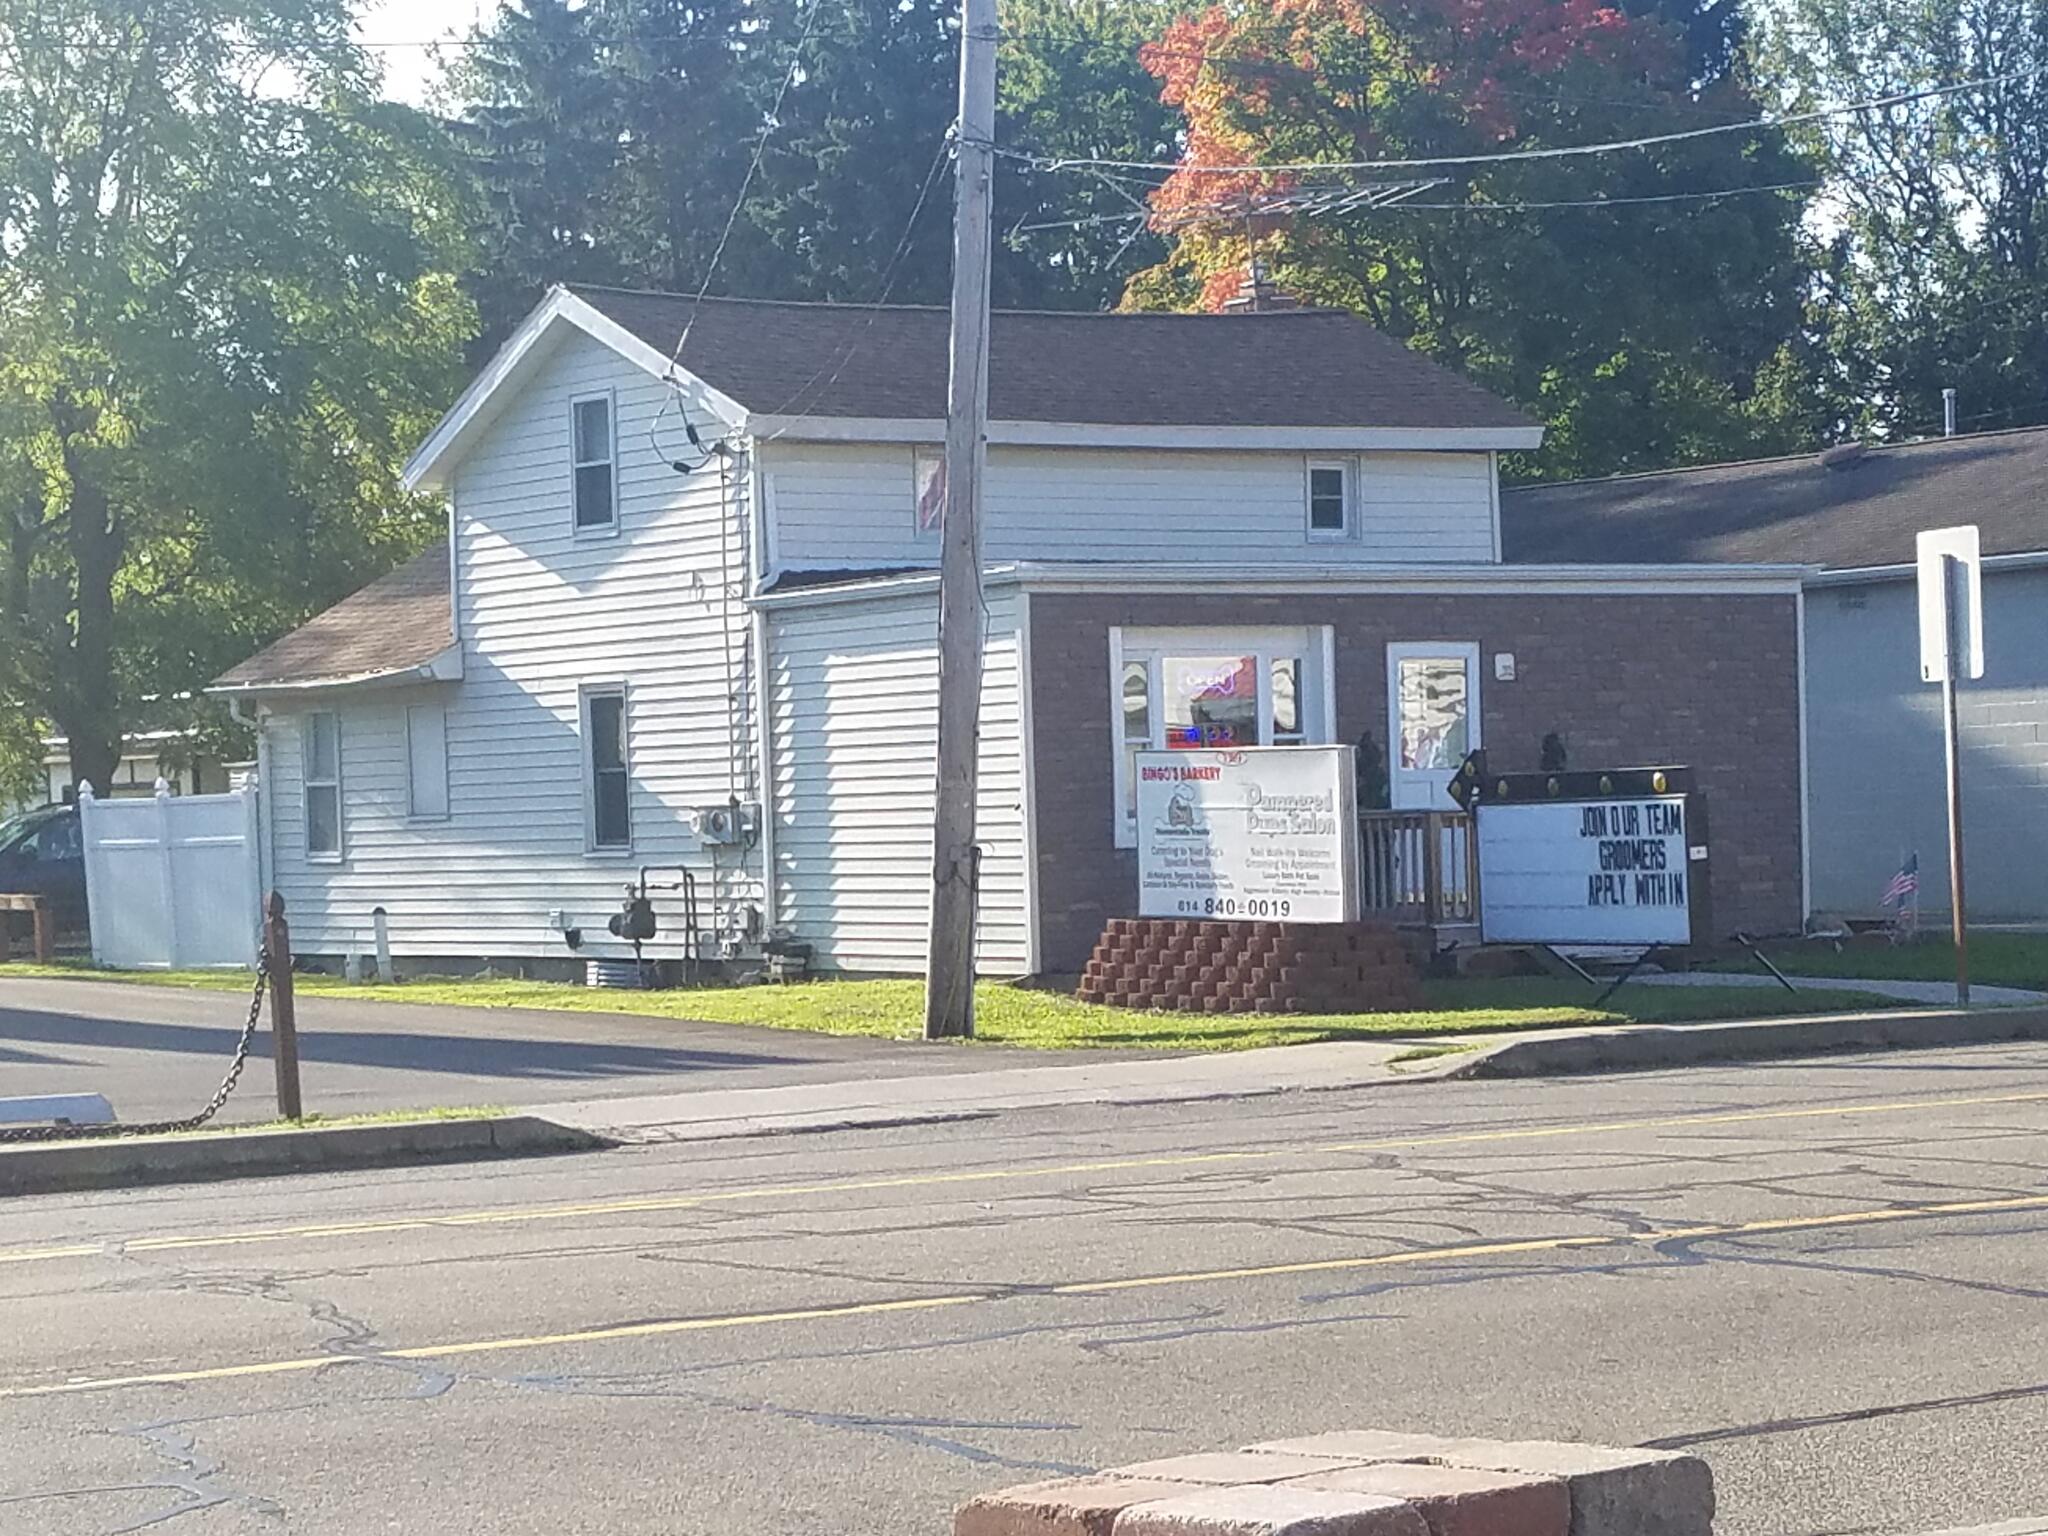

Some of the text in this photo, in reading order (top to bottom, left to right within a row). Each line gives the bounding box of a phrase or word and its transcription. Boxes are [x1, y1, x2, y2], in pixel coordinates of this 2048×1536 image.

[1142, 767, 1178, 781] BINGO'S
[1246, 783, 1333, 816] Pampered
[1290, 811, 1336, 835] Salon
[1580, 803, 1682, 837] JOIN OUR TEAM
[1599, 839, 1667, 871] GROOMERS
[1587, 872, 1684, 906] APPLY WITHIN
